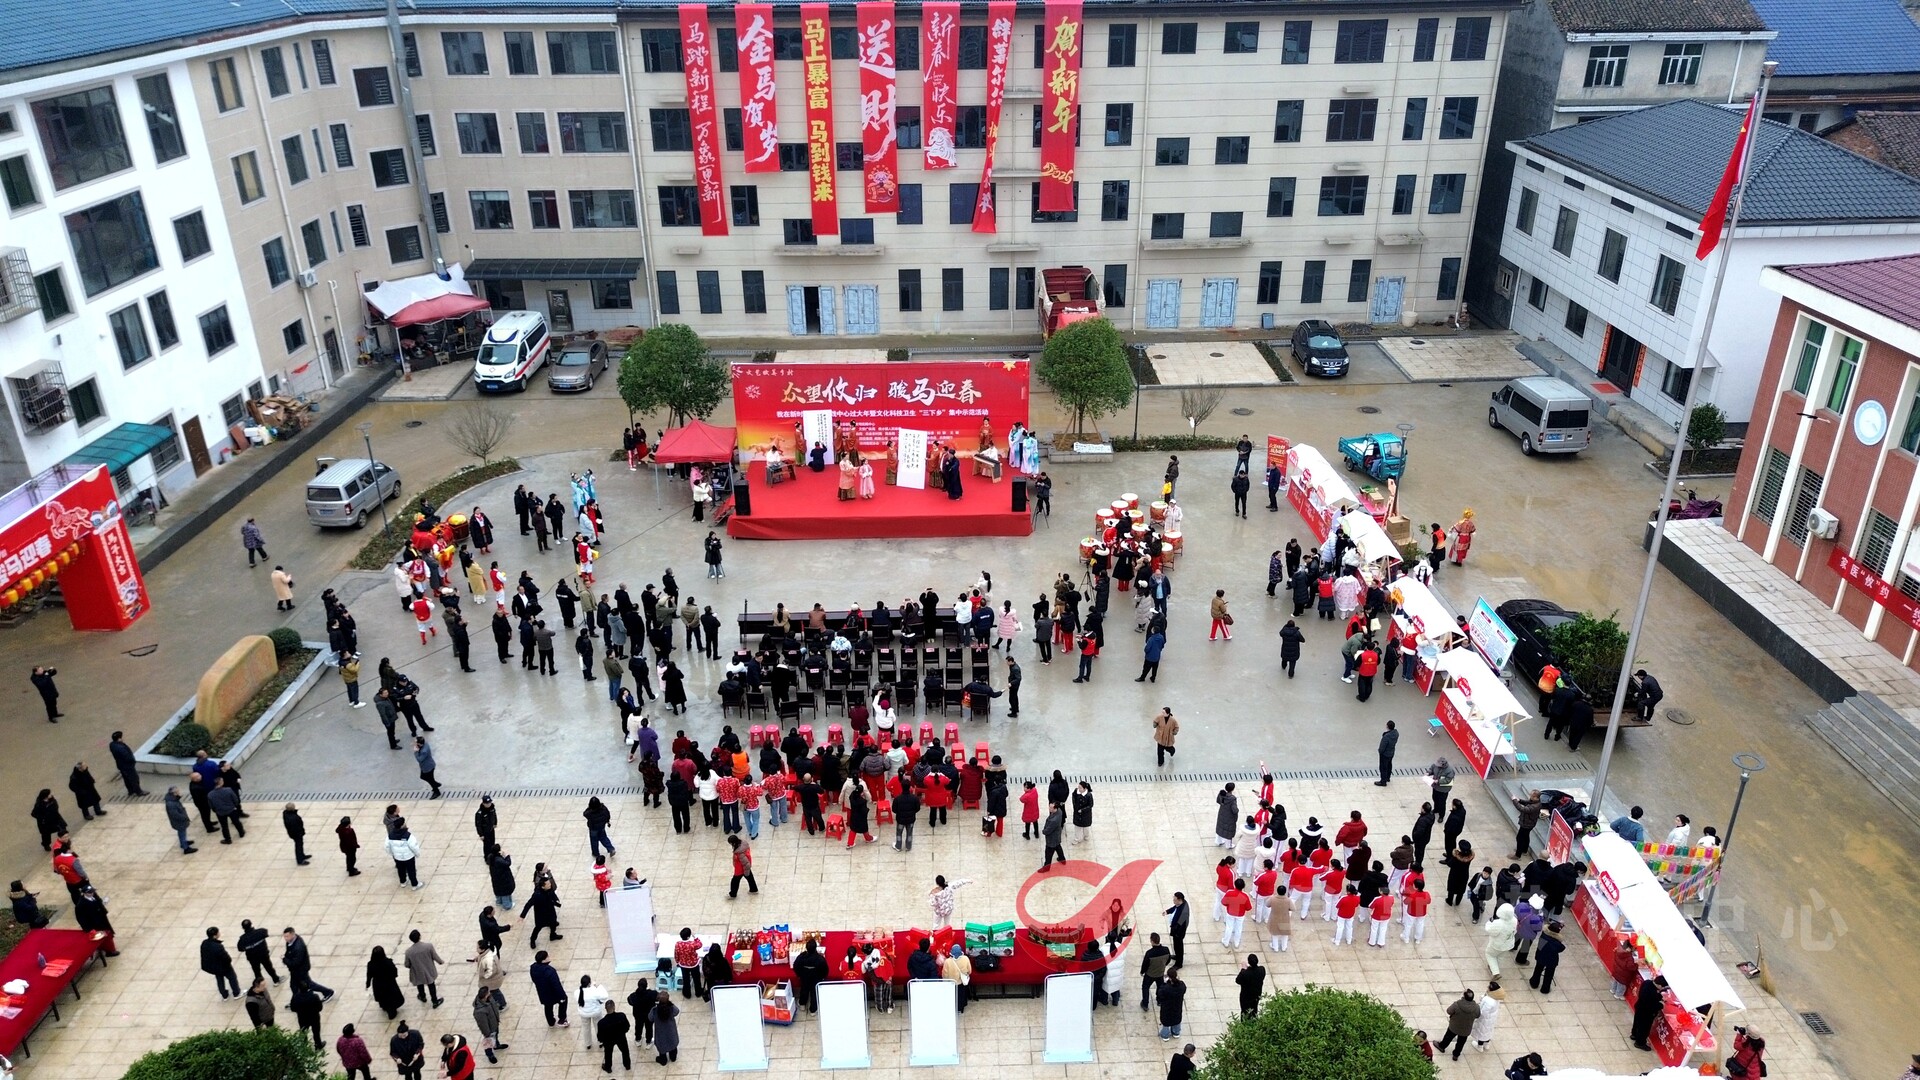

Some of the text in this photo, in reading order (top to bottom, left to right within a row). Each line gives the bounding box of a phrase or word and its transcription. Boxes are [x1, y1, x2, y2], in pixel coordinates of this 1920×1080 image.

[804, 18, 834, 203] 马上暴富 马到钱来
[781, 376, 983, 406] 众望攸归 骏马迎春
